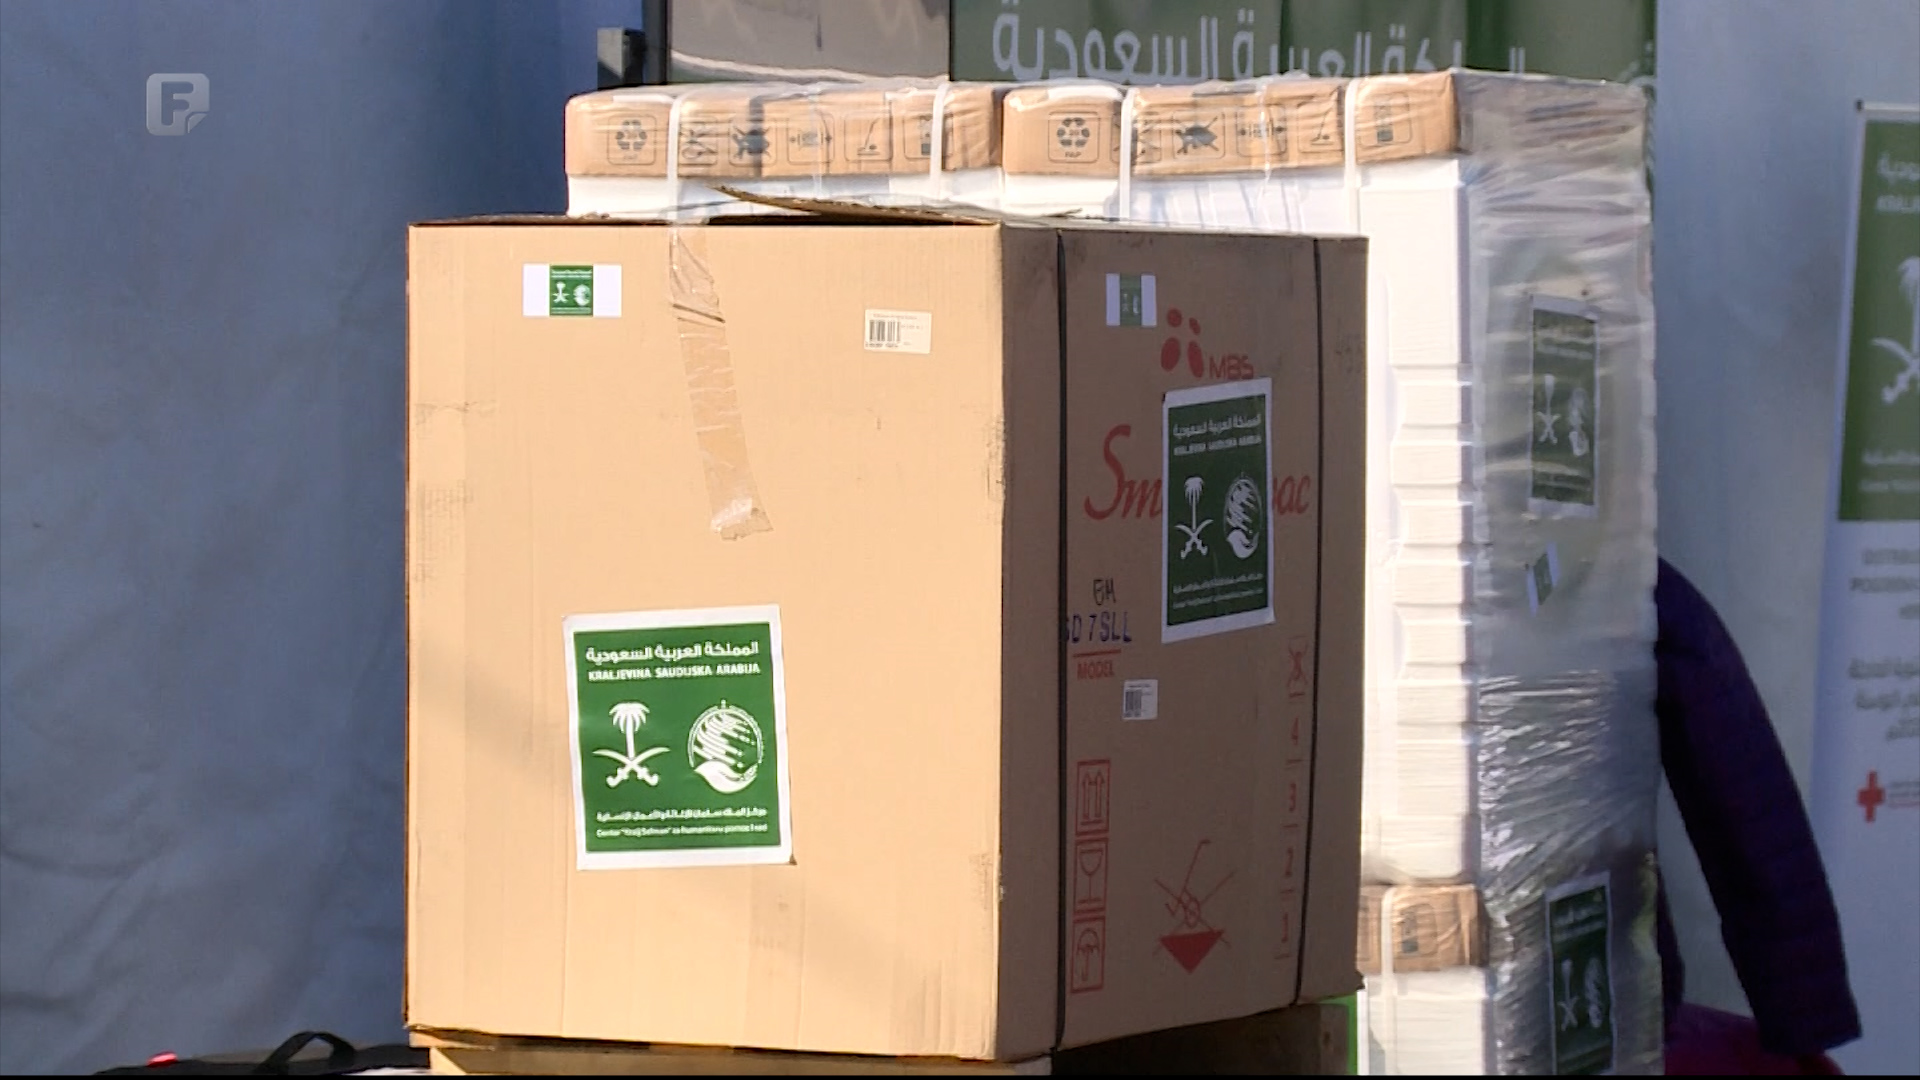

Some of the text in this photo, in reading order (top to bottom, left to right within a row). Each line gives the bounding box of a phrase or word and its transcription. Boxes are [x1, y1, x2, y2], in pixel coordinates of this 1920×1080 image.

[1209, 355, 1254, 380] MBS
[585, 640, 759, 666] المملكة العربية السعودية
[588, 667, 652, 682] KRALJEVINA
[716, 662, 761, 675] ARABIJA
[1077, 660, 1116, 680] MODEL
